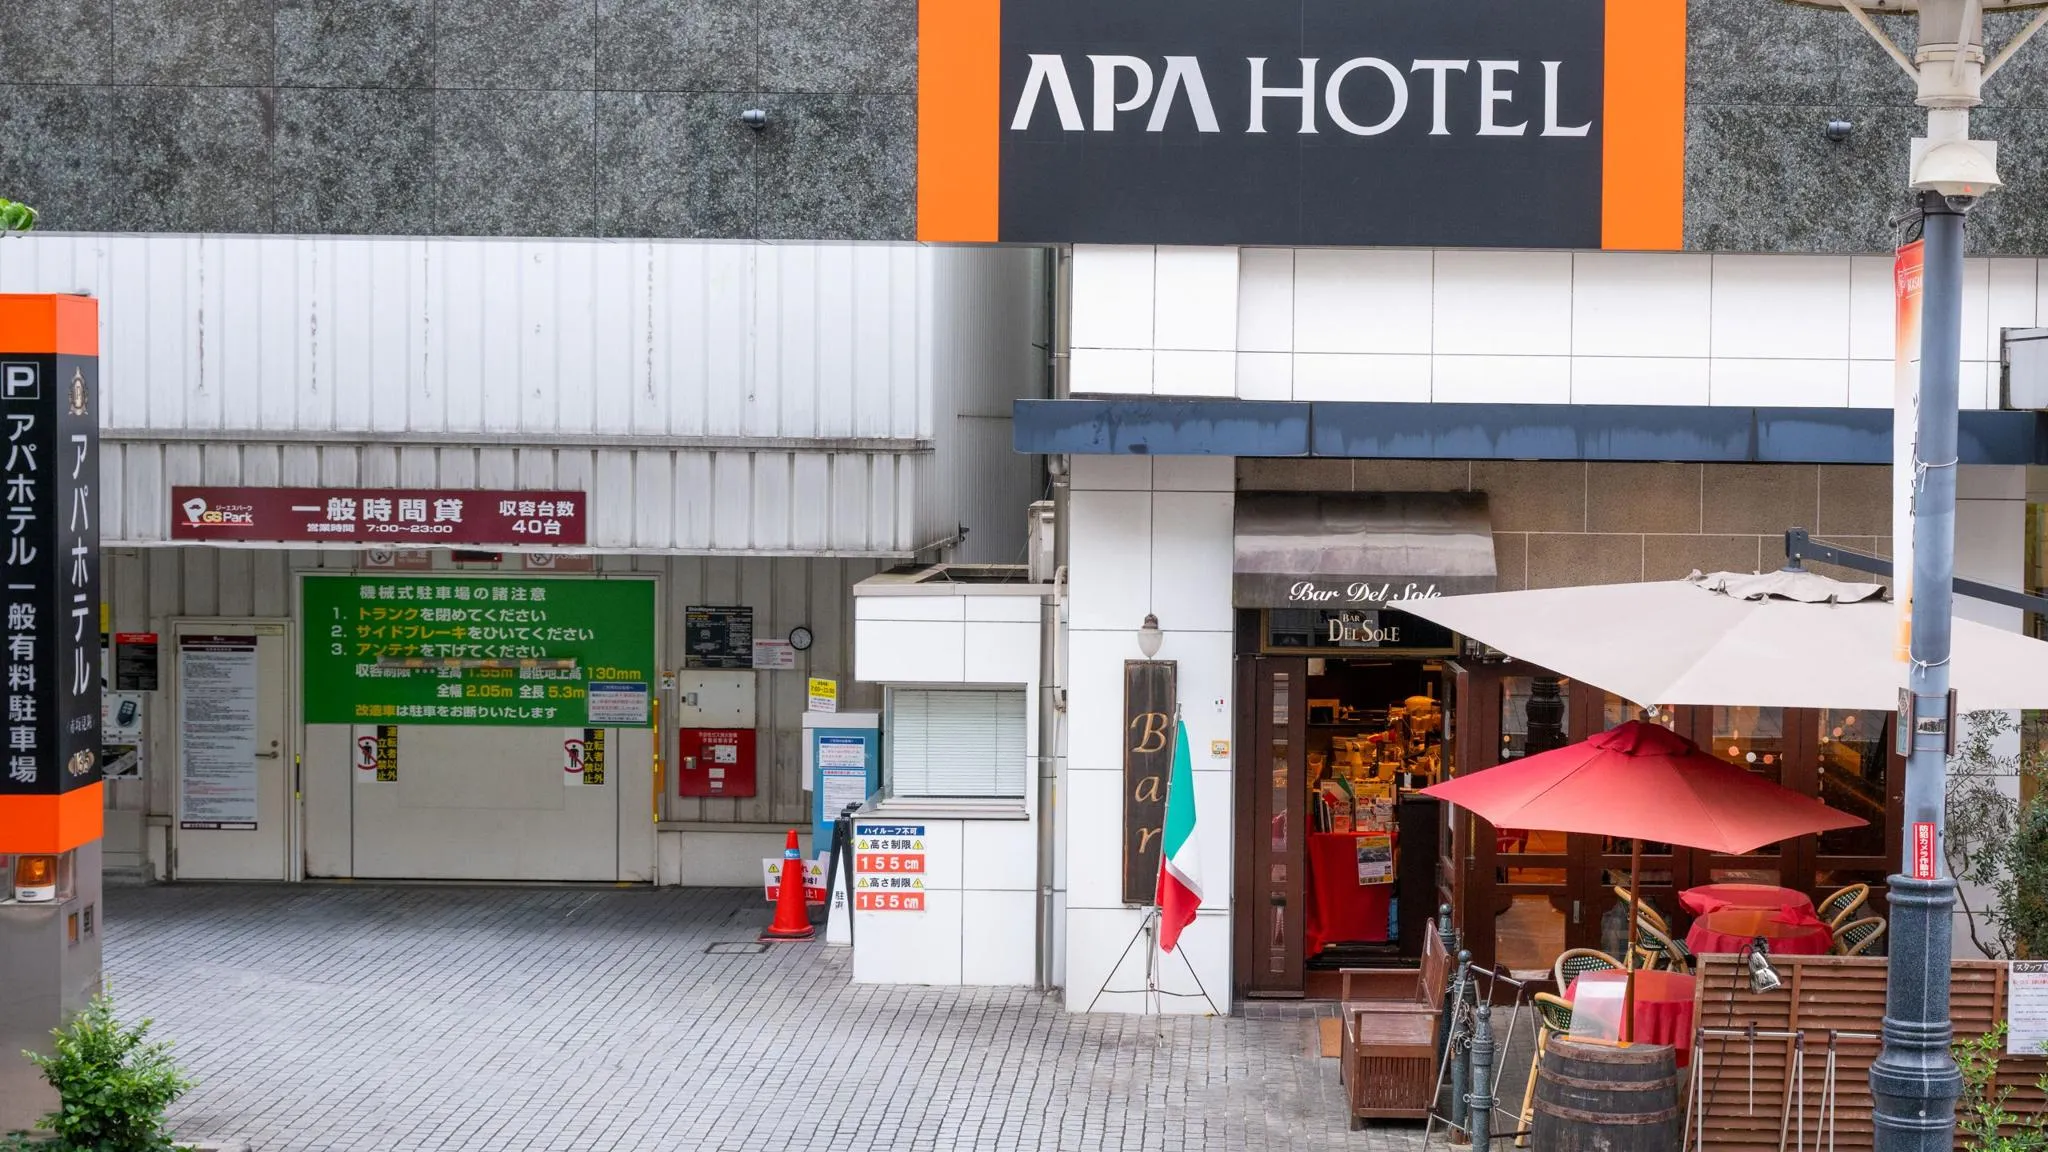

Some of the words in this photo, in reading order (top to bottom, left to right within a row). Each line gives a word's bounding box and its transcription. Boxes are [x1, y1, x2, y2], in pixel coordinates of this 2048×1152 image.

[1010, 53, 1221, 133] APA
[1245, 56, 1593, 138] HOTEL
[5, 414, 37, 566] アパホテル
[291, 497, 464, 523] 一般時間貸
[499, 500, 575, 518] 収容台数
[223, 512, 253, 523] Park
[307, 523, 355, 533] 営業時間
[511, 519, 562, 536] 40台
[70, 434, 90, 697] アパホテル
[359, 585, 547, 601] 機械式駐車場の諸注意
[1288, 581, 1341, 602] Bar
[1345, 582, 1391, 602] Del
[359, 607, 547, 622] トランクを閉めてください
[1342, 613, 1361, 623] BAR
[356, 625, 595, 641] サイドブレーキをひいてください
[356, 643, 547, 658] アンテナを下げてください
[588, 667, 642, 680] 130mm
[7, 583, 37, 784] 一般有料駐車場
[437, 683, 462, 698] 全幅
[466, 685, 513, 698] 2.05m
[519, 684, 545, 699] 全長
[548, 686, 585, 699] 5.3m
[1130, 711, 1168, 854] Bar
[864, 827, 918, 836] ハイルーフ不可
[869, 839, 912, 850] 高さ制限
[1919, 824, 1930, 878] 防犯カメラ作動中
[869, 878, 912, 888] 高さ制限
